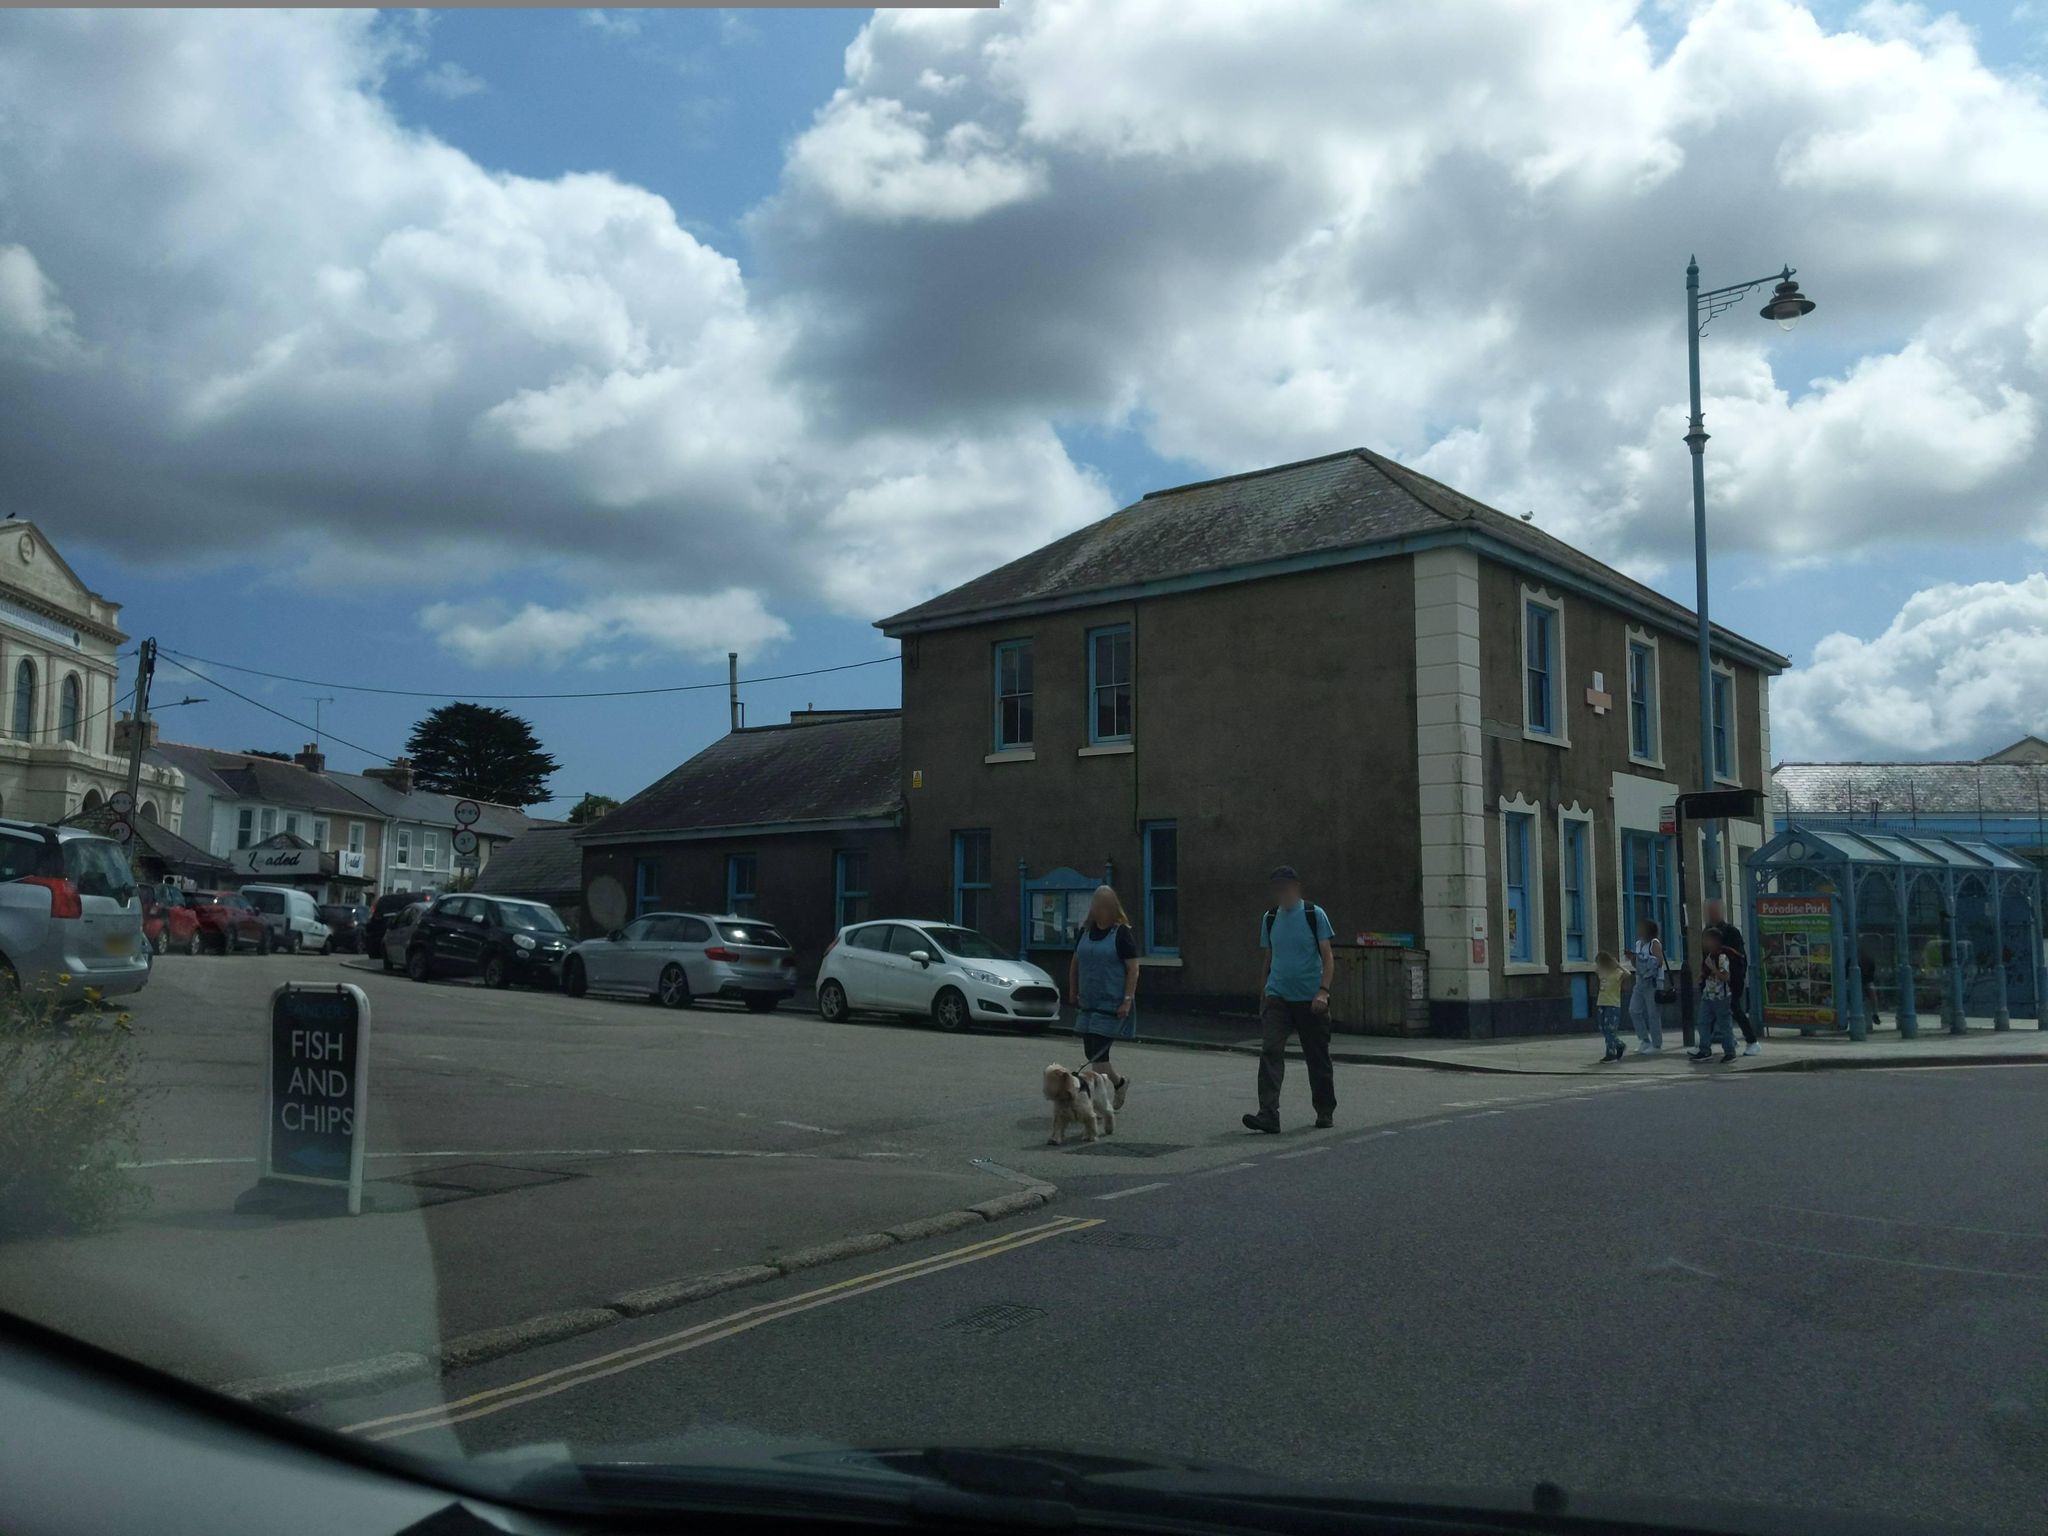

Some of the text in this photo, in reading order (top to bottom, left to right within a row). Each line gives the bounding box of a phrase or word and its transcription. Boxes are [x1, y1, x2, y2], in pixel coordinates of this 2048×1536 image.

[248, 851, 301, 873] Laded
[1762, 902, 1828, 914] Paradise Park
[291, 1030, 344, 1061] FISH
[287, 1066, 348, 1098] AND
[281, 1102, 354, 1136] CHIPS
